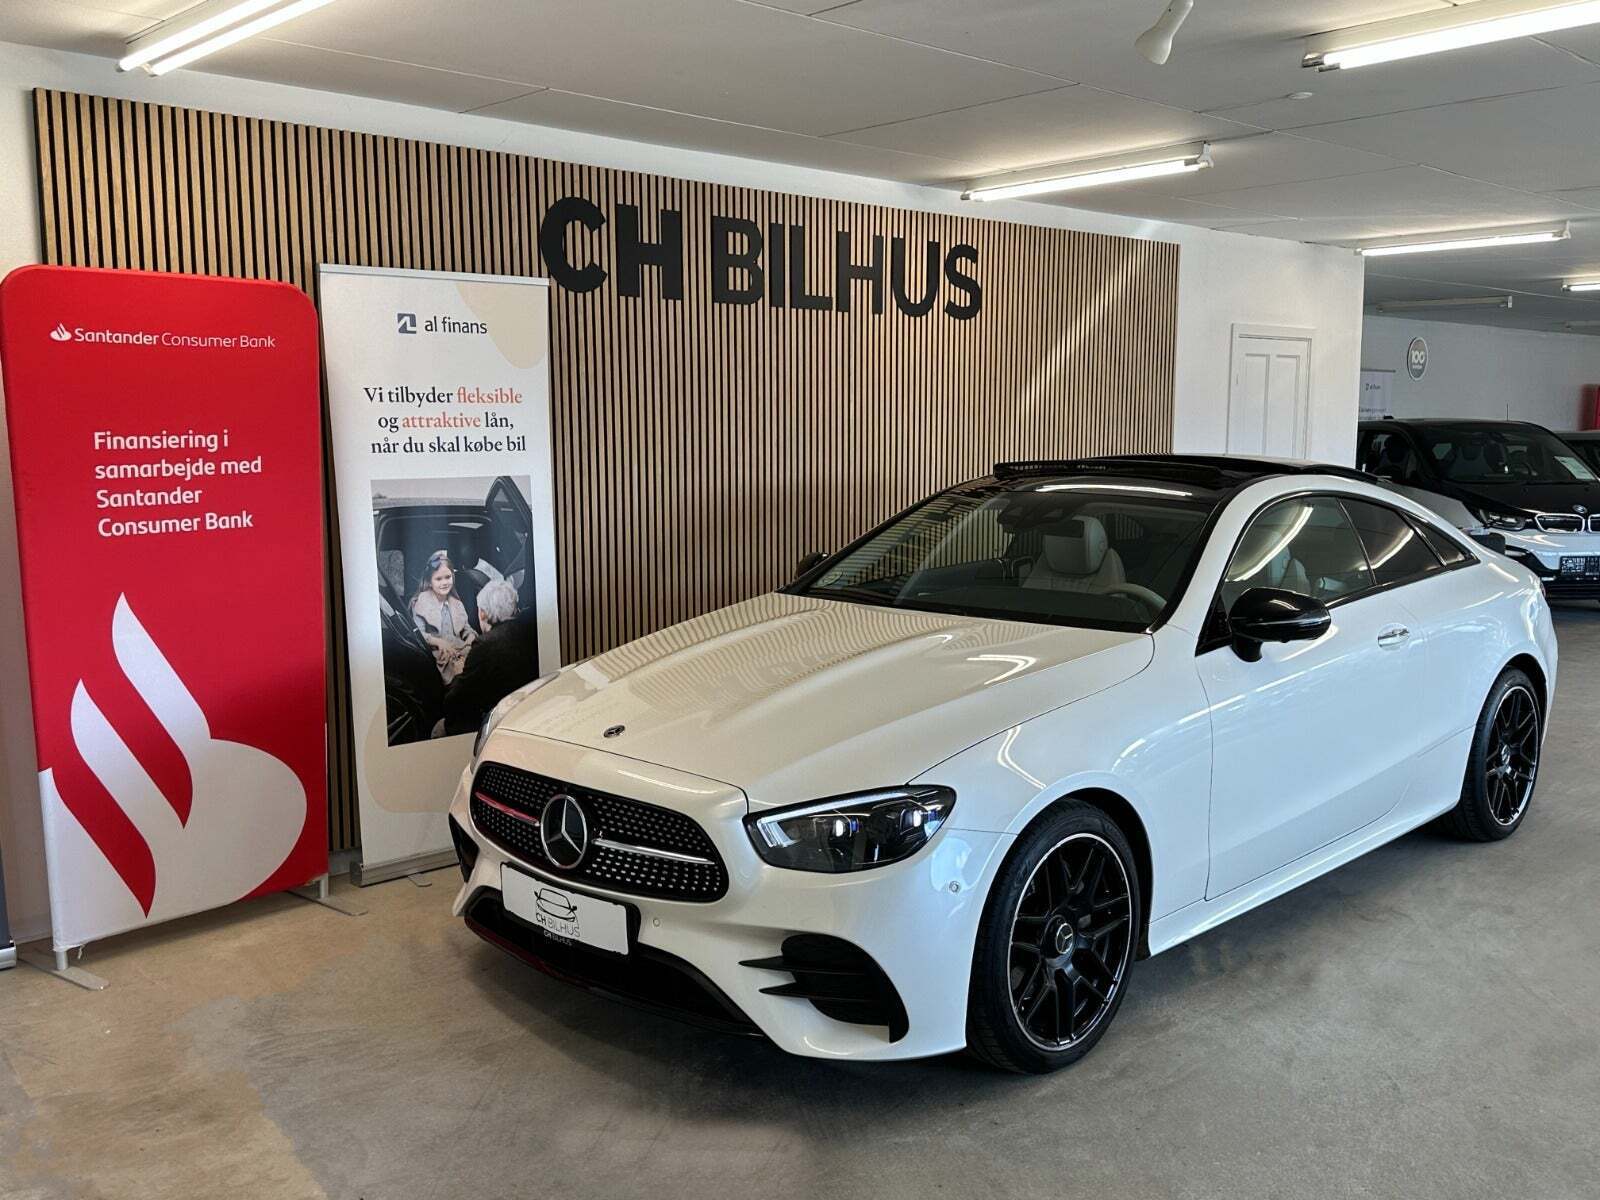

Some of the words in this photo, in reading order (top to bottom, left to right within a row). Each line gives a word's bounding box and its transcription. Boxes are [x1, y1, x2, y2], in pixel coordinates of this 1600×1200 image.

[540, 196, 684, 301] CH
[711, 215, 981, 321] BILHUS
[424, 316, 438, 332] al
[442, 317, 488, 334] finans
[74, 327, 159, 346] Santander
[161, 332, 237, 348] Consumer
[239, 335, 276, 349] Bank
[1411, 350, 1425, 364] 100
[363, 386, 384, 403] Vi
[388, 386, 453, 408] tilbyder
[457, 386, 523, 404] fleksible
[377, 415, 399, 433] og
[402, 412, 481, 428] attraktive
[485, 412, 514, 430] lån,
[94, 430, 218, 453] Finansiering
[223, 429, 228, 447] i
[370, 437, 399, 454] når
[402, 436, 425, 453] du
[428, 436, 461, 453] skal
[464, 435, 503, 453] købe
[506, 435, 527, 452] bil
[95, 458, 216, 481] samarbejde
[220, 455, 262, 475] med
[96, 486, 203, 509] Santander
[98, 516, 201, 537] Consumer
[205, 510, 253, 531] Bank
[536, 912, 547, 925] CH
[547, 918, 581, 938] BILHUS
